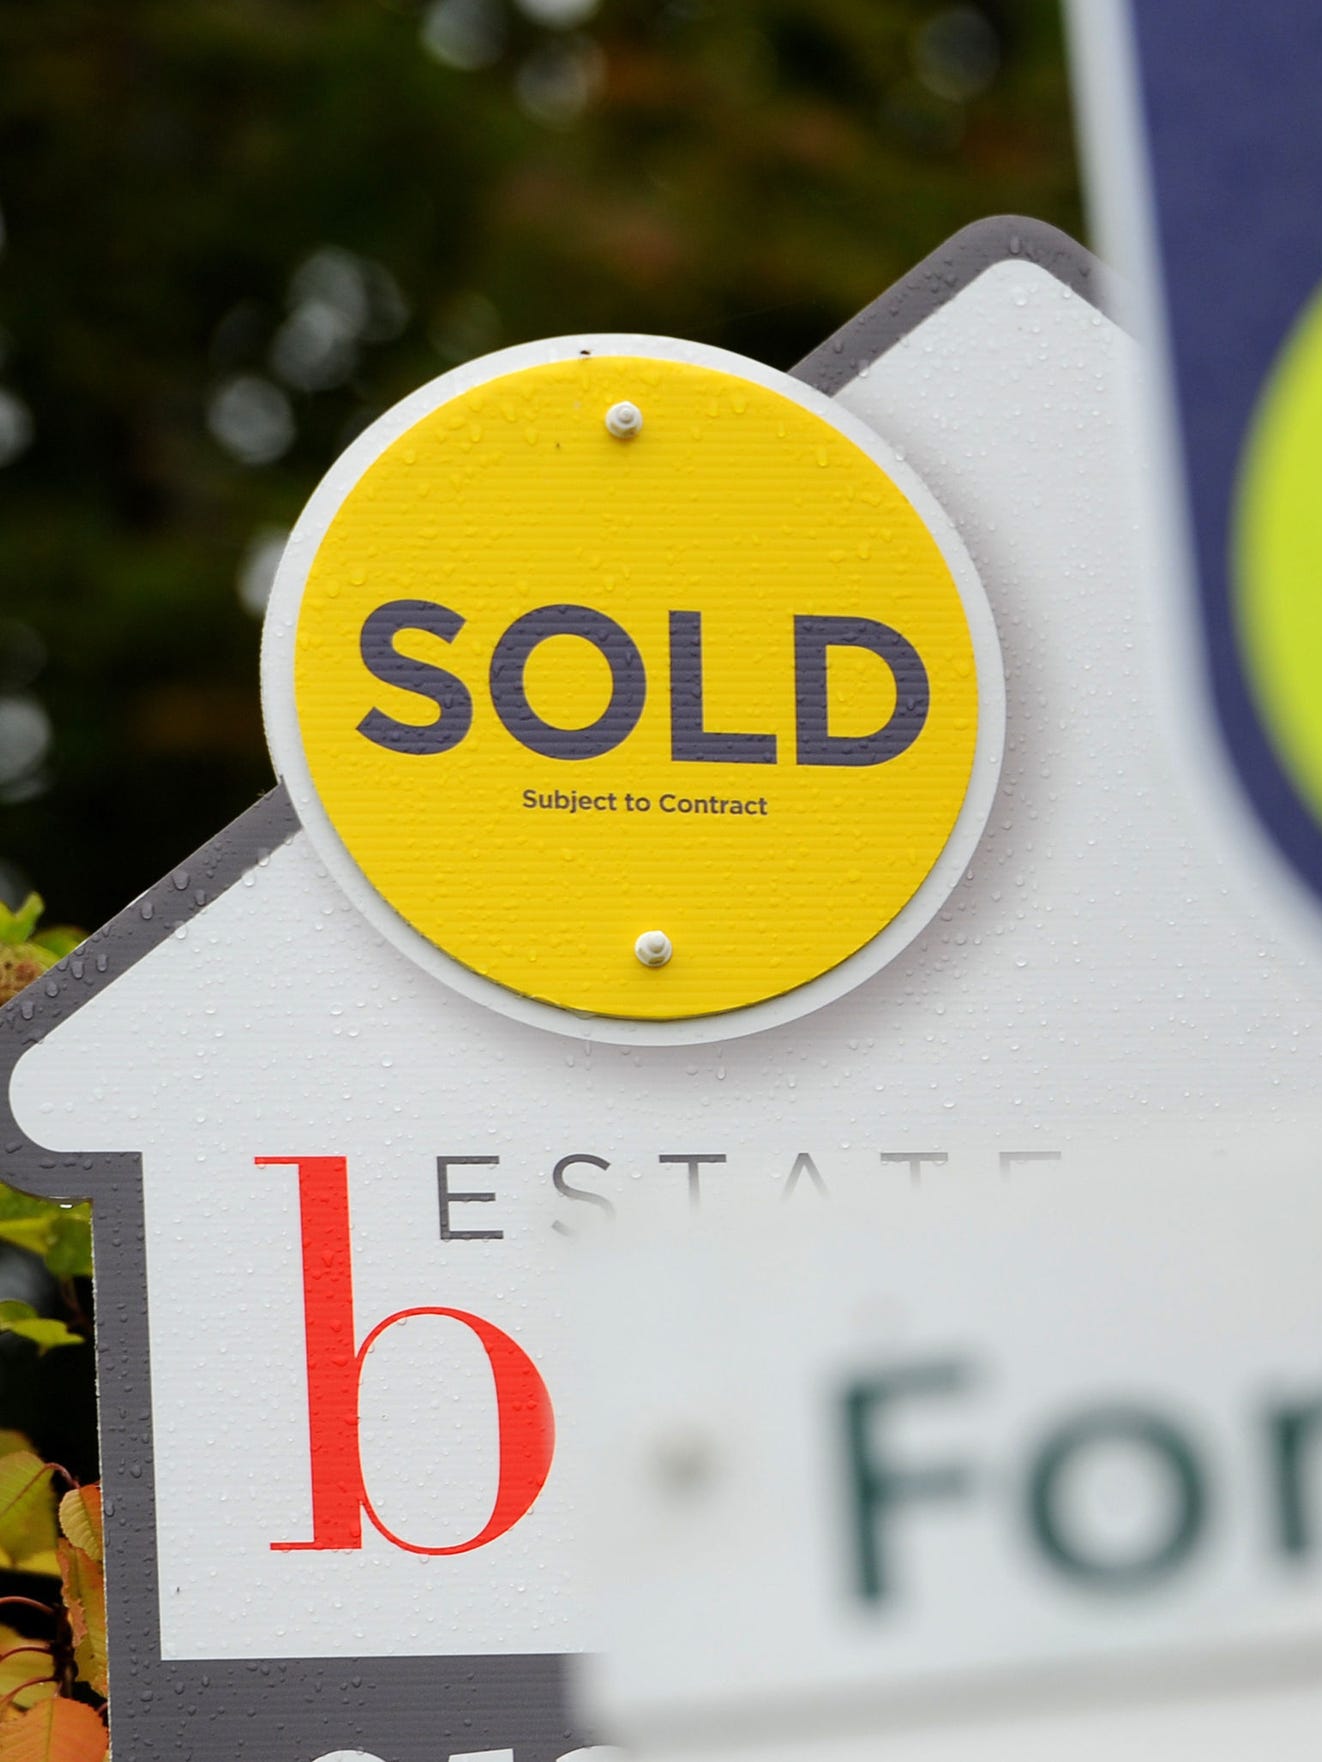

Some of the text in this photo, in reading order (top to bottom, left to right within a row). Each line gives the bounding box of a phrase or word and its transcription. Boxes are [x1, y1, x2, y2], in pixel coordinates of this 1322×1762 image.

[355, 599, 930, 767] SOLD
[522, 789, 768, 815] Subject to Contract
